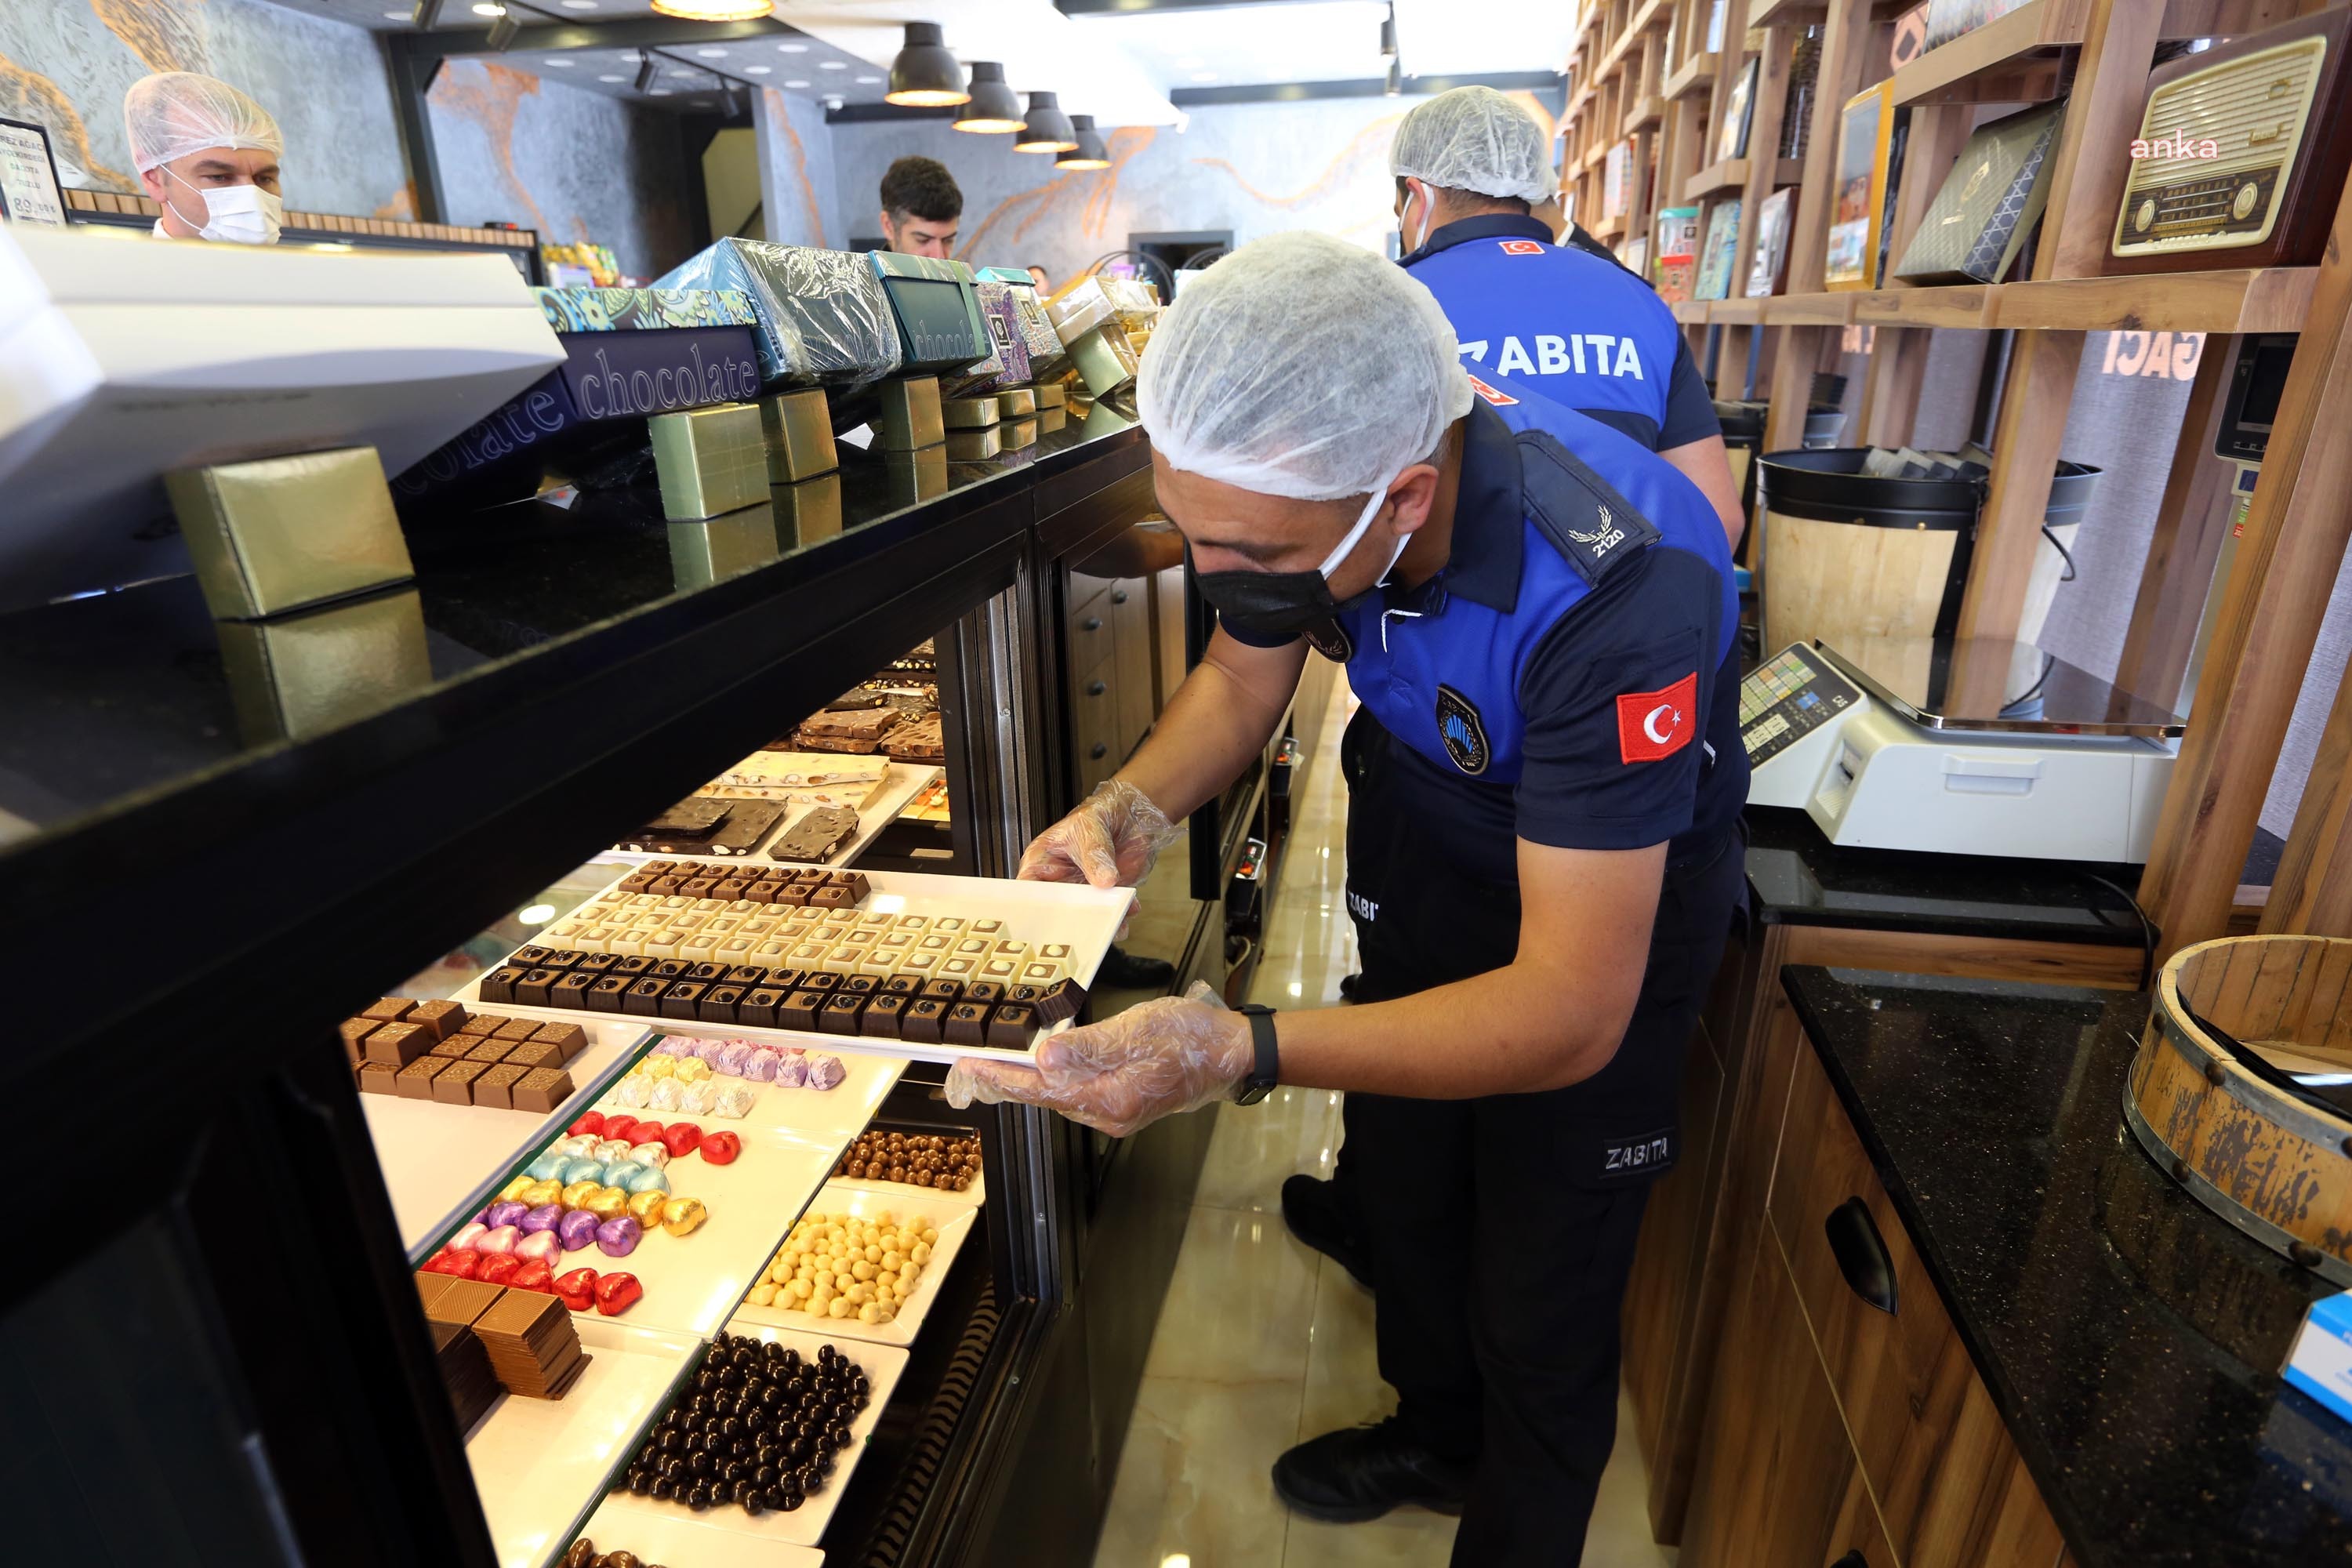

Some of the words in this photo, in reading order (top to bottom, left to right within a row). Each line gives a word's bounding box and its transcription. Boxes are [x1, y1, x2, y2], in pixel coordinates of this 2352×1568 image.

[581, 343, 757, 419] chocolate
[1592, 528, 1625, 558] 2120
[1606, 1138, 1668, 1170] ZABITA
